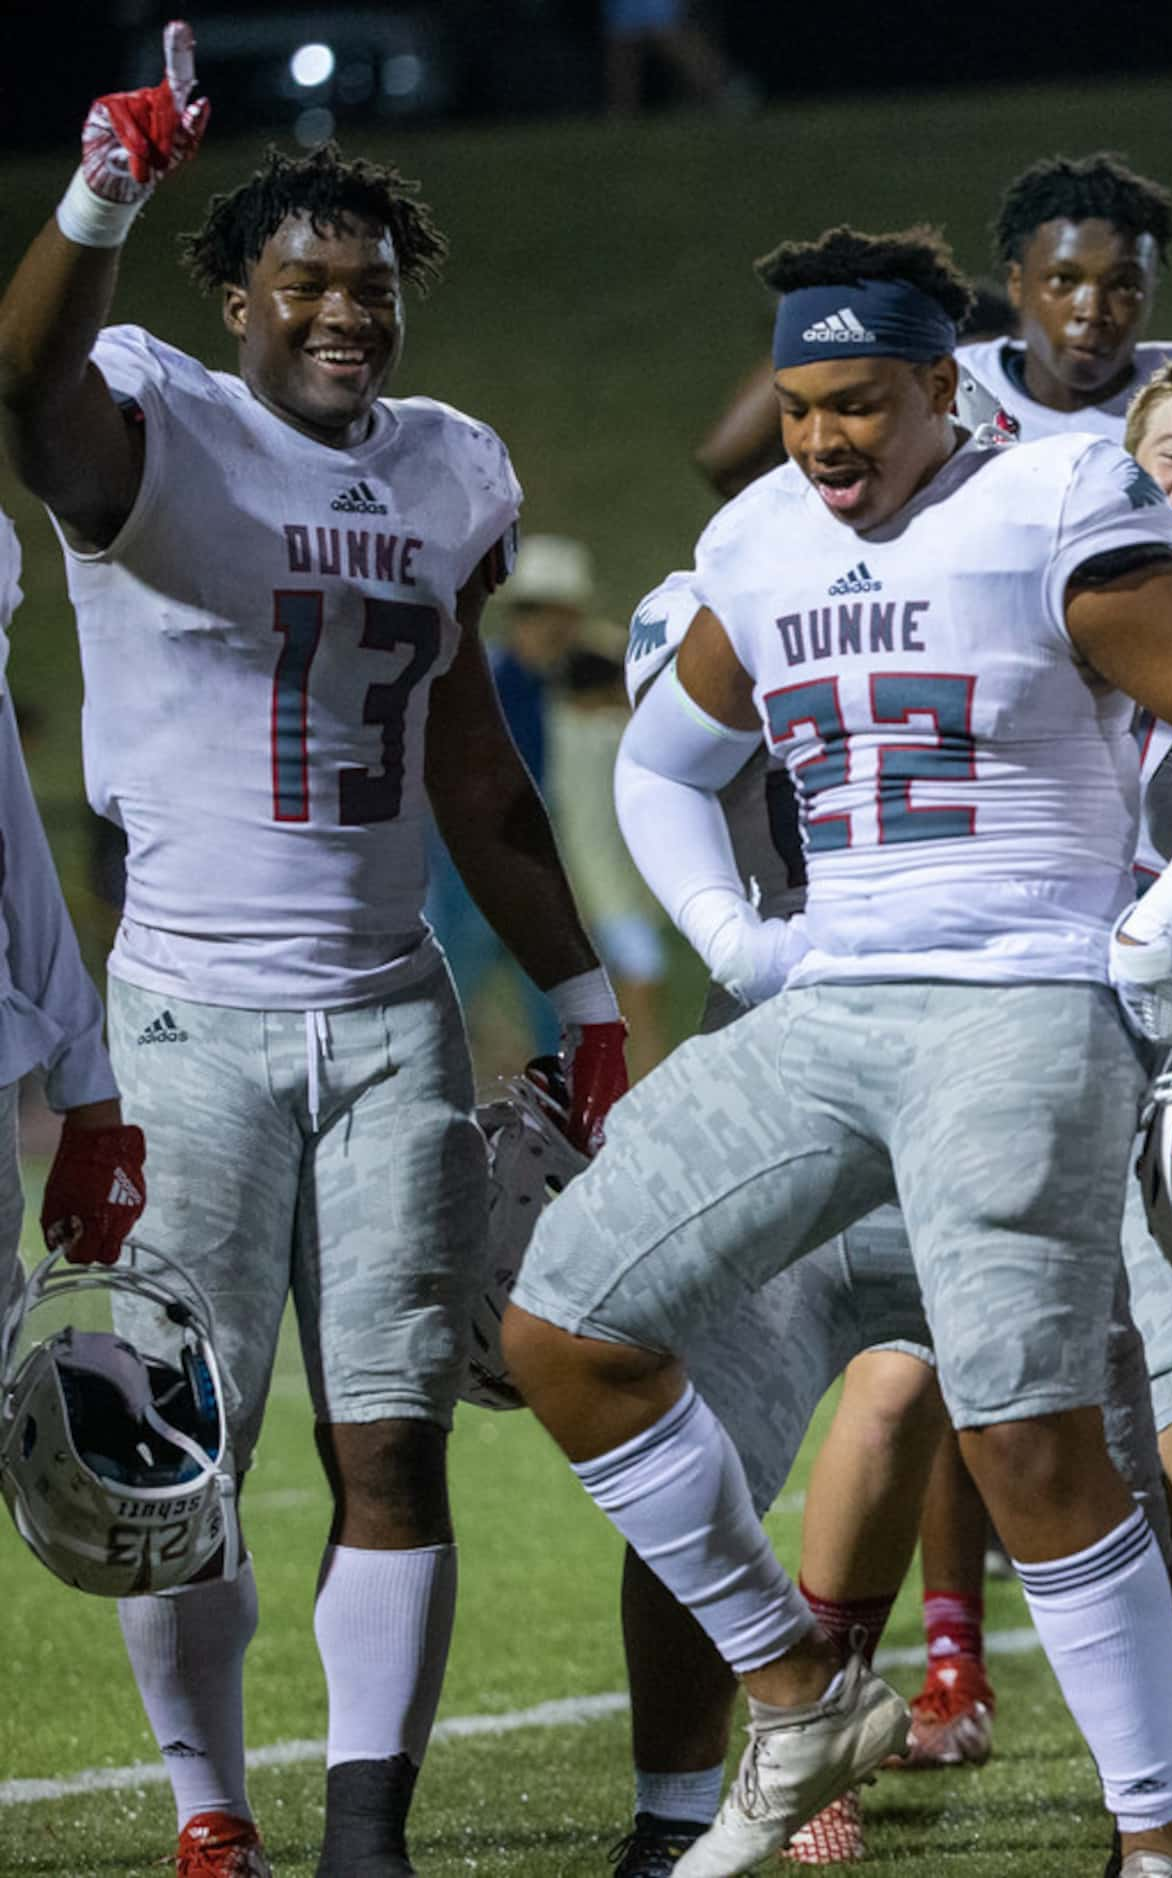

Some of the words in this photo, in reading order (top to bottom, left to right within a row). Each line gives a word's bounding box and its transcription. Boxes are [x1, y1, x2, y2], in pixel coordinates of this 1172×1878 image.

[331, 499, 387, 515] adidas
[283, 525, 424, 586] DUNNE
[828, 580, 883, 597] adidas
[776, 600, 930, 667] DUNNE
[271, 589, 442, 826] 13
[763, 671, 978, 854] 22
[137, 1030, 188, 1045] adidas
